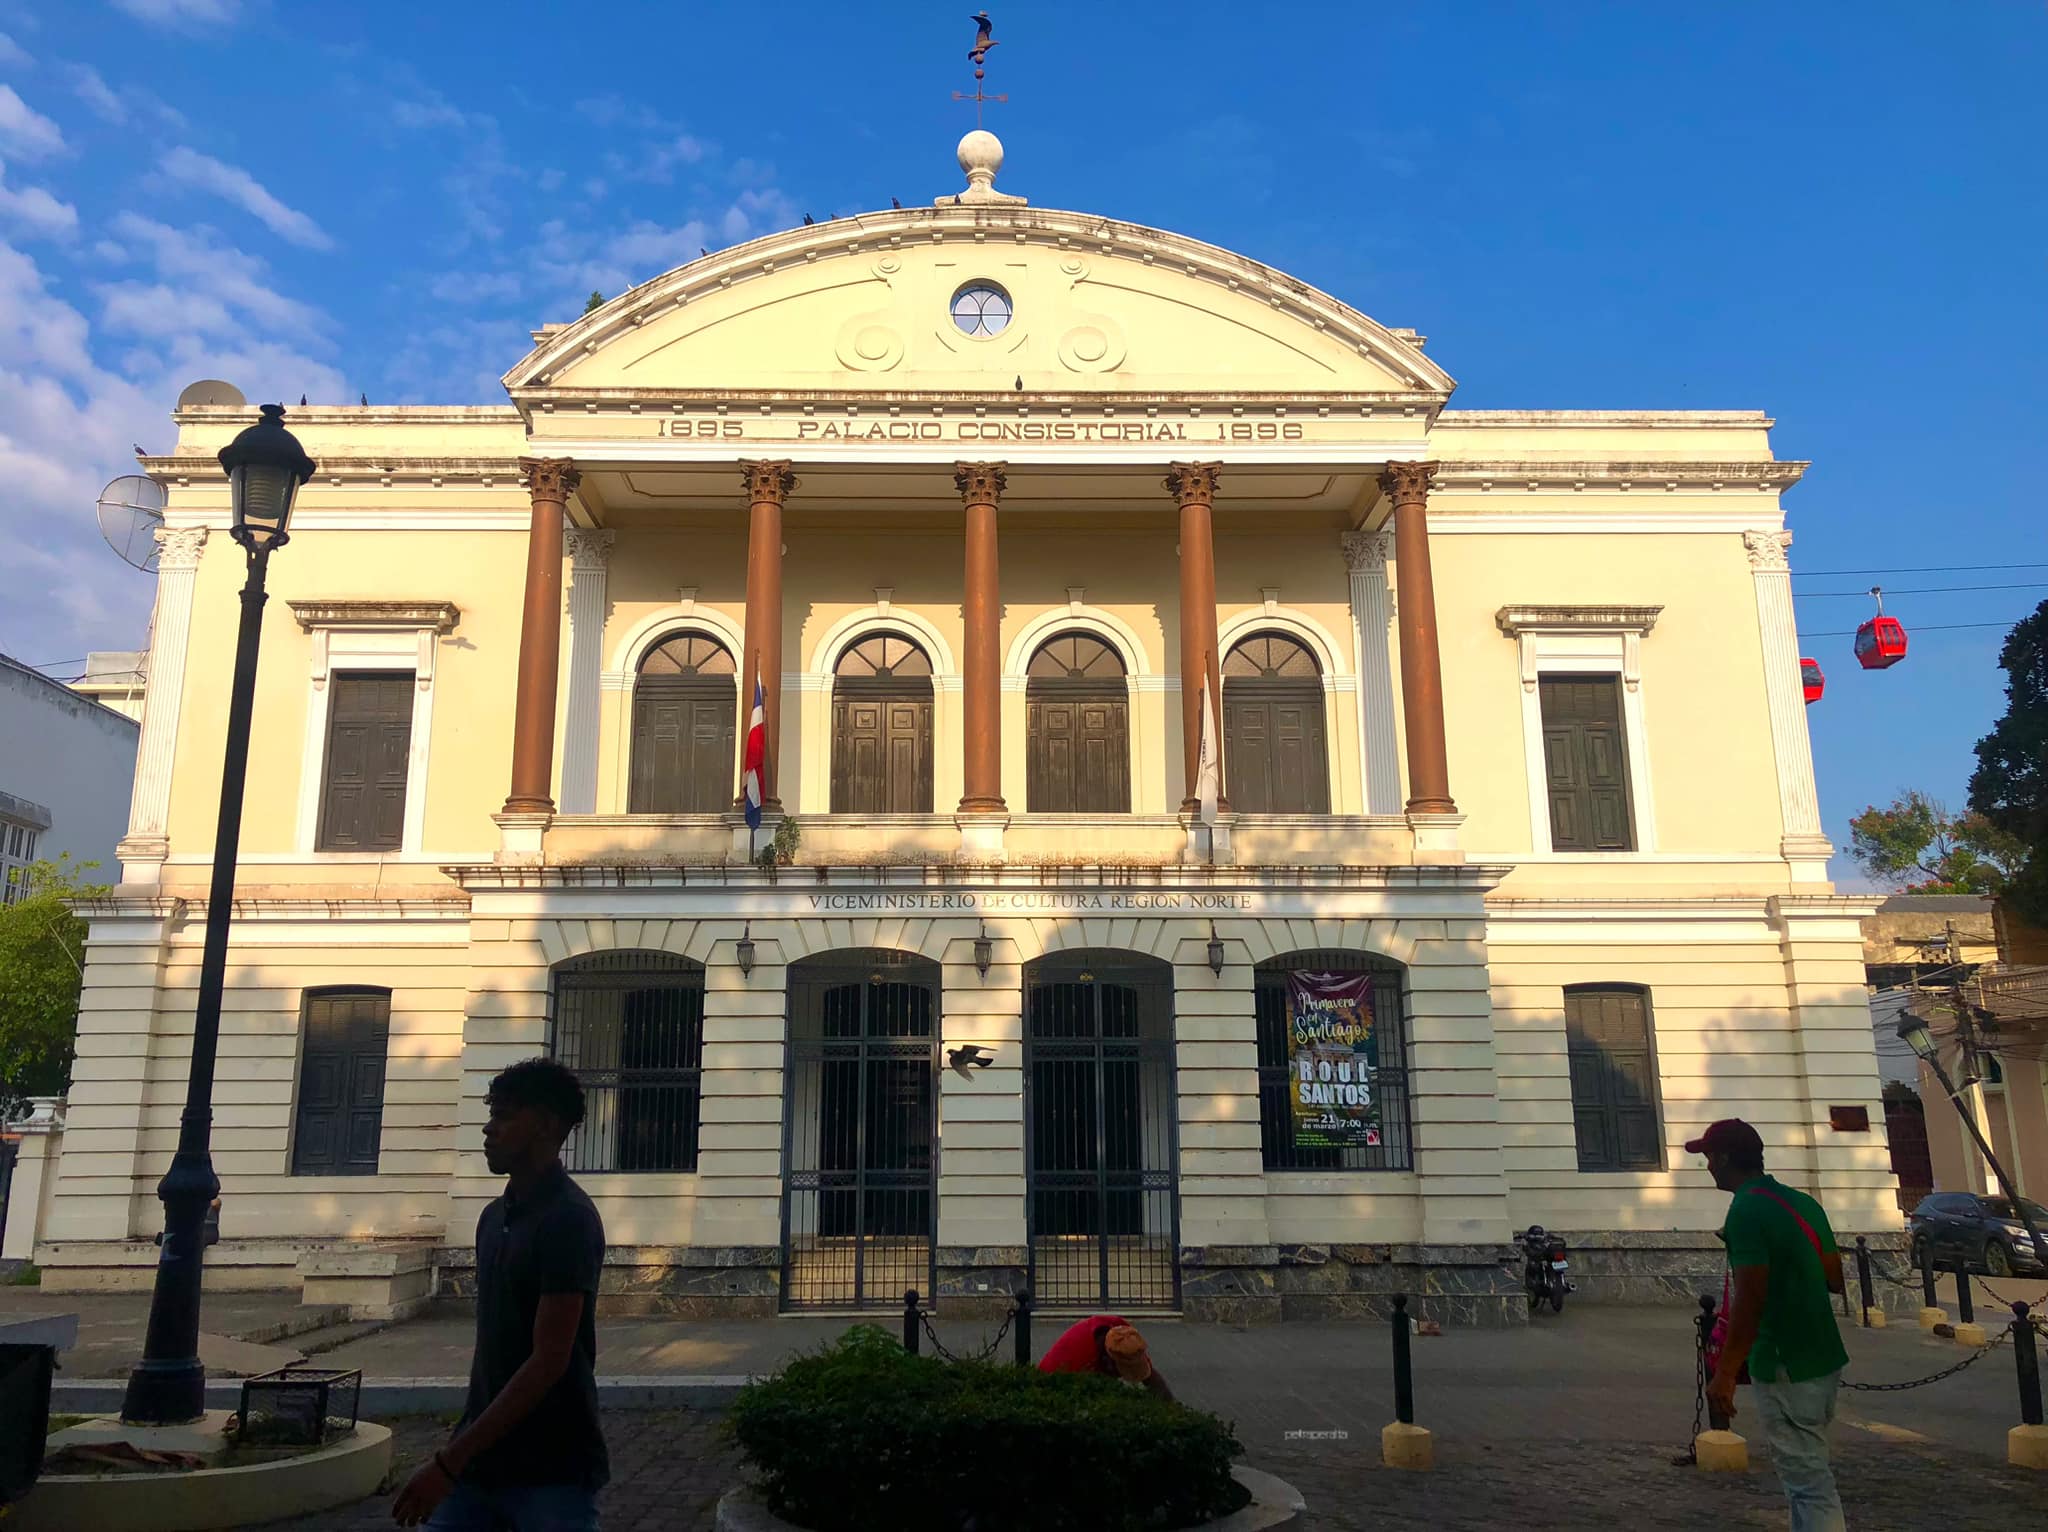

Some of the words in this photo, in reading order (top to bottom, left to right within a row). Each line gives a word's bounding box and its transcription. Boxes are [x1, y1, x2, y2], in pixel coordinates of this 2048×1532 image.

[658, 419, 744, 437] 1895
[797, 421, 943, 439] PALACIO
[957, 422, 1188, 440] CONSISTORIAL
[1217, 423, 1304, 440] 1896
[808, 894, 976, 910] VICEMINISTERIO
[981, 894, 1006, 909] DE
[1010, 894, 1104, 909] CULTURA
[1110, 894, 1182, 910] REGION
[1189, 894, 1253, 909] NORTE
[1297, 991, 1356, 1015] Primavera
[1306, 1012, 1318, 1024] en
[1295, 1015, 1361, 1046] Santiago
[1299, 1060, 1369, 1083] ROUL
[1299, 1082, 1370, 1106] SANTOS
[1302, 1122, 1312, 1130] de
[1313, 1122, 1337, 1130] marzo
[1320, 1113, 1336, 1124] 21
[1340, 1119, 1362, 1128] 7:00
